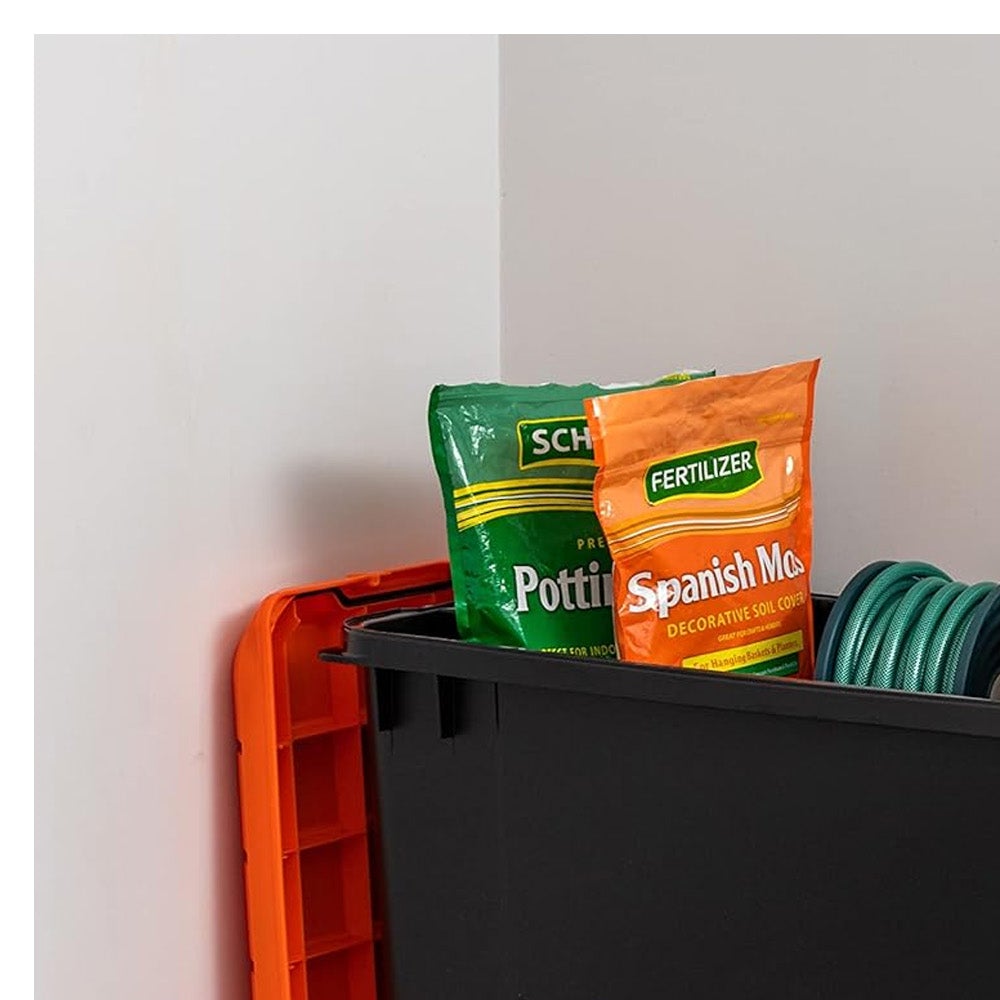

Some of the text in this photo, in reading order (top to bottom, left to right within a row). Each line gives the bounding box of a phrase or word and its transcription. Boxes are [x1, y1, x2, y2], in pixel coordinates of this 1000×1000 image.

[531, 427, 592, 455] SCH
[651, 450, 753, 493] FERTILIZER
[577, 536, 605, 550] PRE
[627, 551, 757, 619] Spanish
[667, 608, 751, 638] DECORATIVE
[753, 601, 776, 618] SOIL
[711, 654, 746, 671] Hanging
